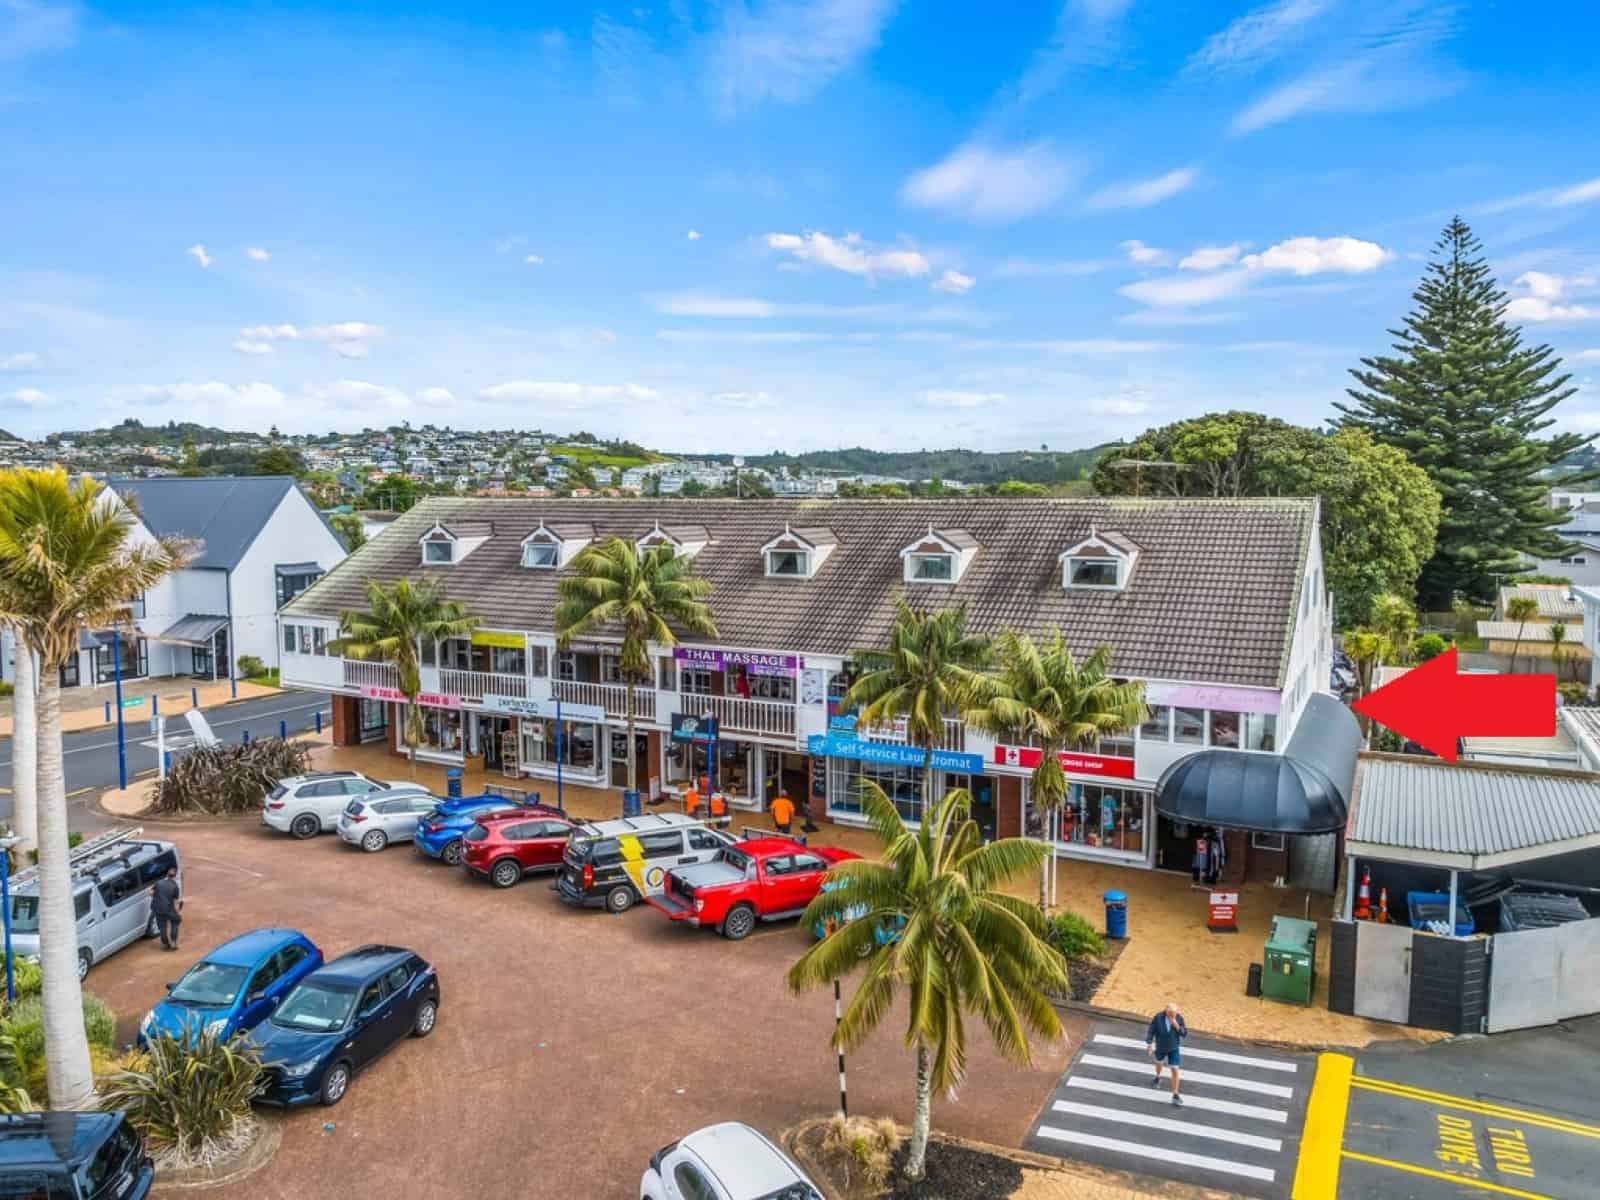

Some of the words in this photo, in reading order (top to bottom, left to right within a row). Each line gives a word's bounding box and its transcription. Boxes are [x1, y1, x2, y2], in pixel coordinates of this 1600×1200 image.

[687, 650, 716, 661] THAI
[722, 652, 787, 667] MASSAGE
[836, 742, 857, 754] Self
[858, 744, 898, 760] Service
[1487, 1127, 1535, 1178] THRU
